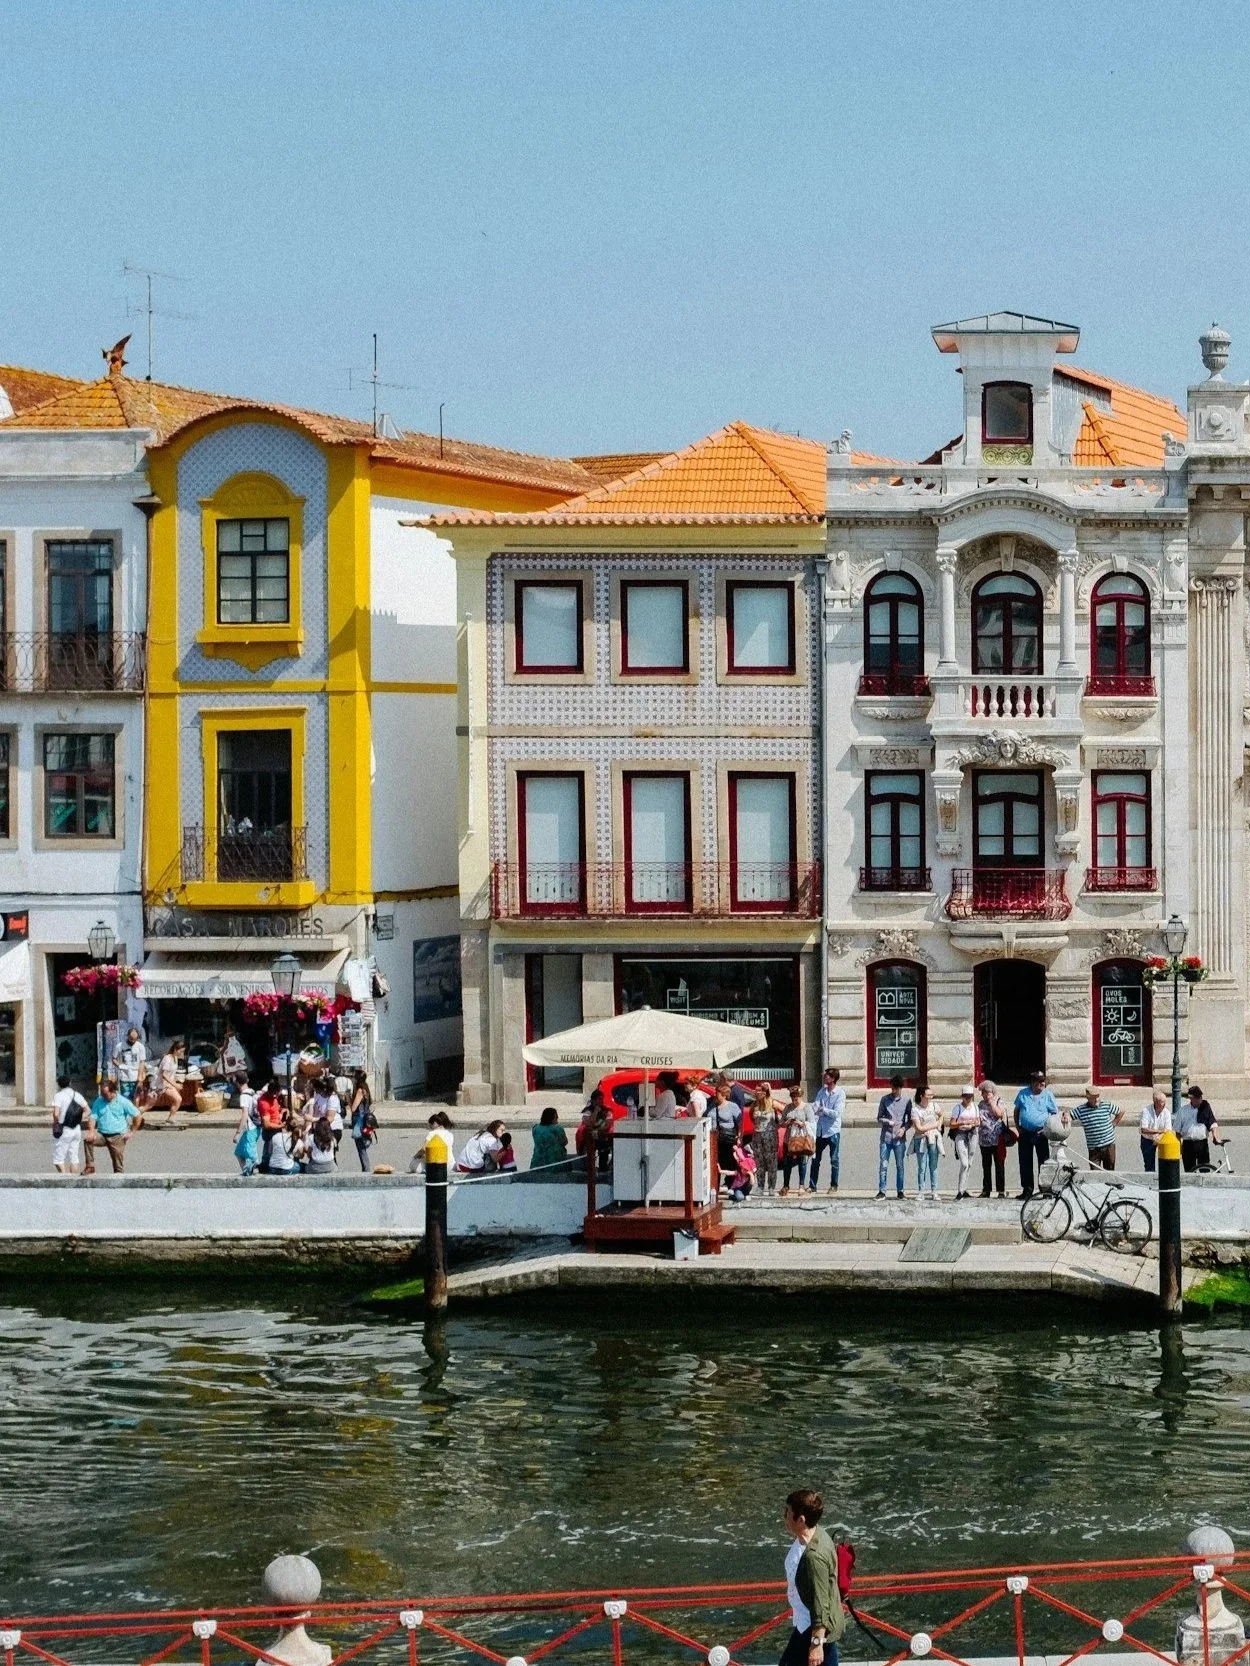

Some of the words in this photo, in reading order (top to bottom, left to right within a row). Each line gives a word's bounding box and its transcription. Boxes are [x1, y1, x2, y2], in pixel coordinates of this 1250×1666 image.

[227, 917, 324, 937] MARQUES
[607, 1055, 618, 1064] RIA
[640, 1056, 673, 1066] CRUISES
